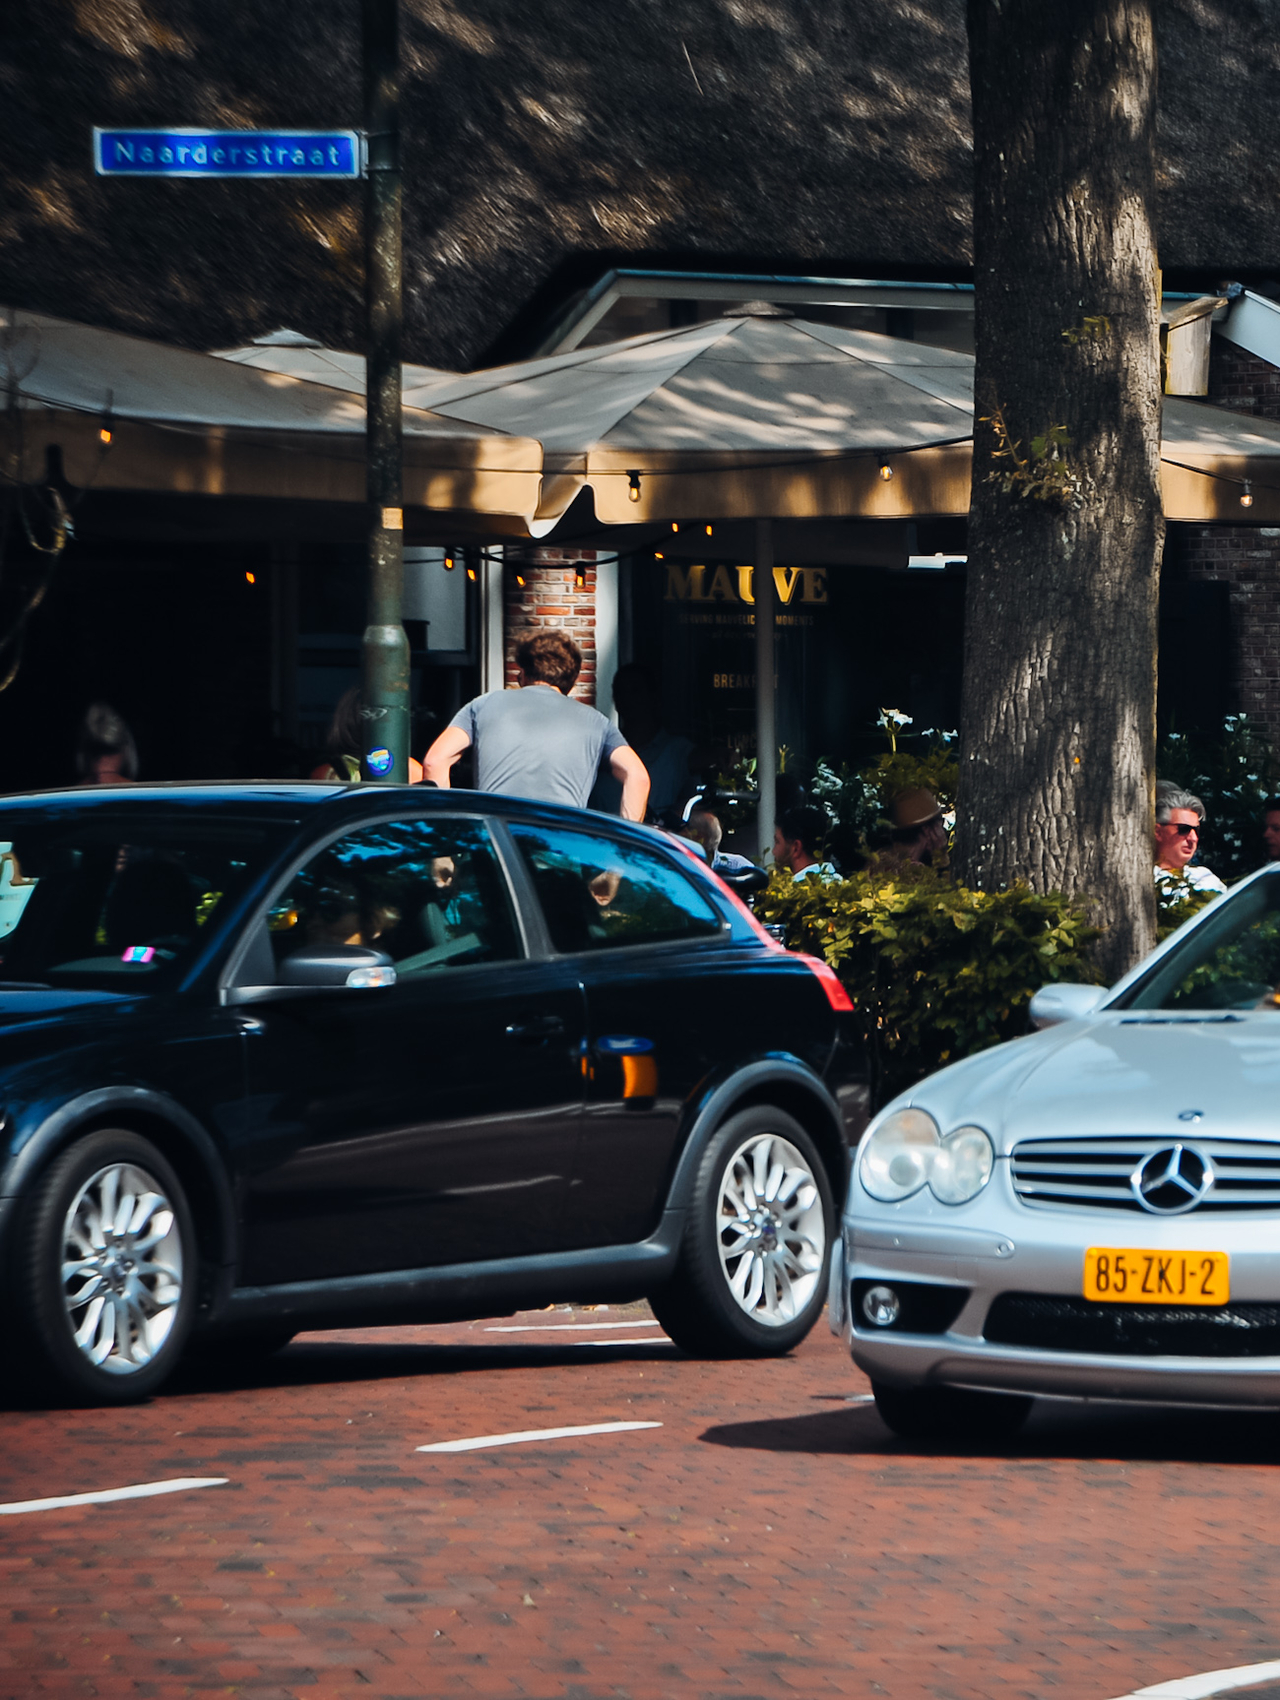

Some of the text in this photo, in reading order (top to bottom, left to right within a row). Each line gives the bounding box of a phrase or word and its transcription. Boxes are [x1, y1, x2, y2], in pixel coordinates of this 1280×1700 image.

[114, 141, 341, 166] Naarderstraat
[775, 615, 814, 626] MOMENTS
[713, 673, 779, 689] BREAKFT
[1096, 1255, 1216, 1295] 85-ZKJ-2
